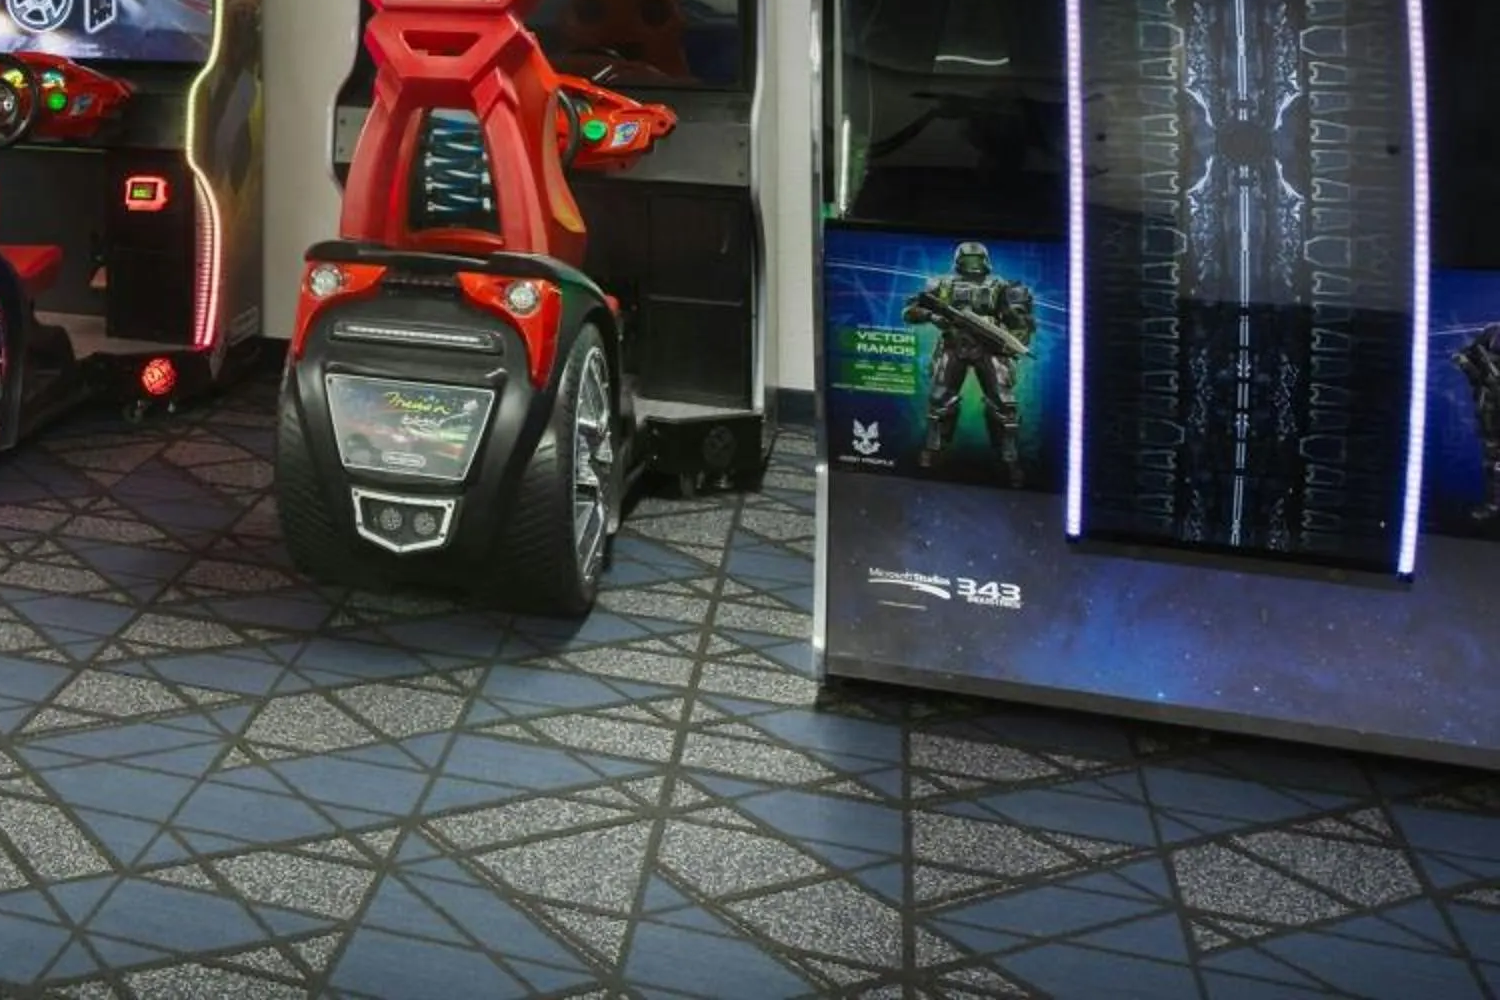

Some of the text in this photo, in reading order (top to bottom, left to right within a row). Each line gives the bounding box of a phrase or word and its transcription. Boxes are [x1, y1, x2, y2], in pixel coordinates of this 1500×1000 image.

[856, 331, 916, 344] VICTOR
[857, 342, 917, 357] RAMOS
[956, 577, 1021, 600] 343
